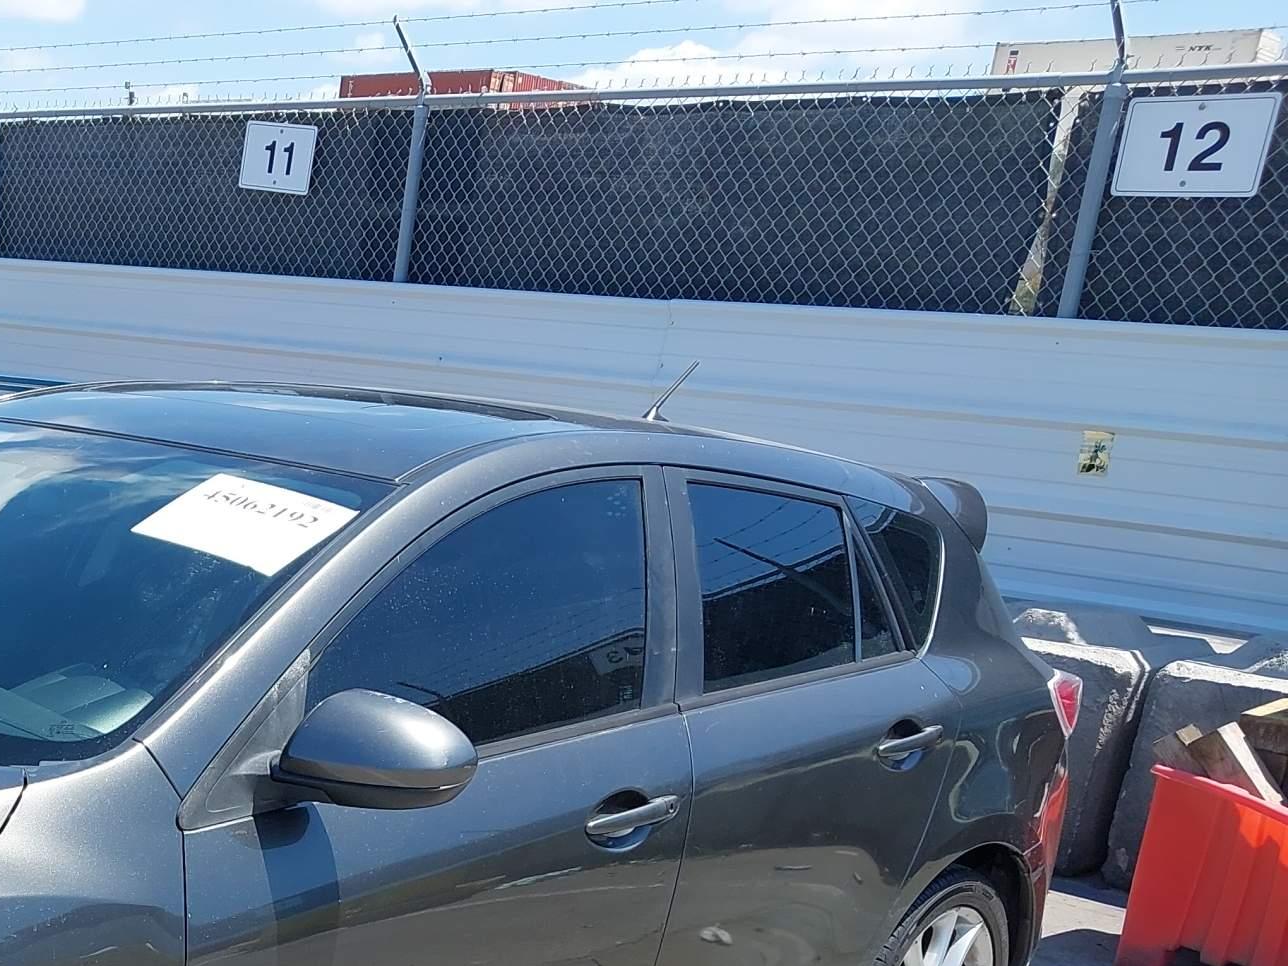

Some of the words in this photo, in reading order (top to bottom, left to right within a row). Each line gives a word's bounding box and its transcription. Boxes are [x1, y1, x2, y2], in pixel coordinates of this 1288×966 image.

[264, 140, 295, 176] 11
[1159, 121, 1231, 172] 12
[203, 489, 319, 528] 45062192
